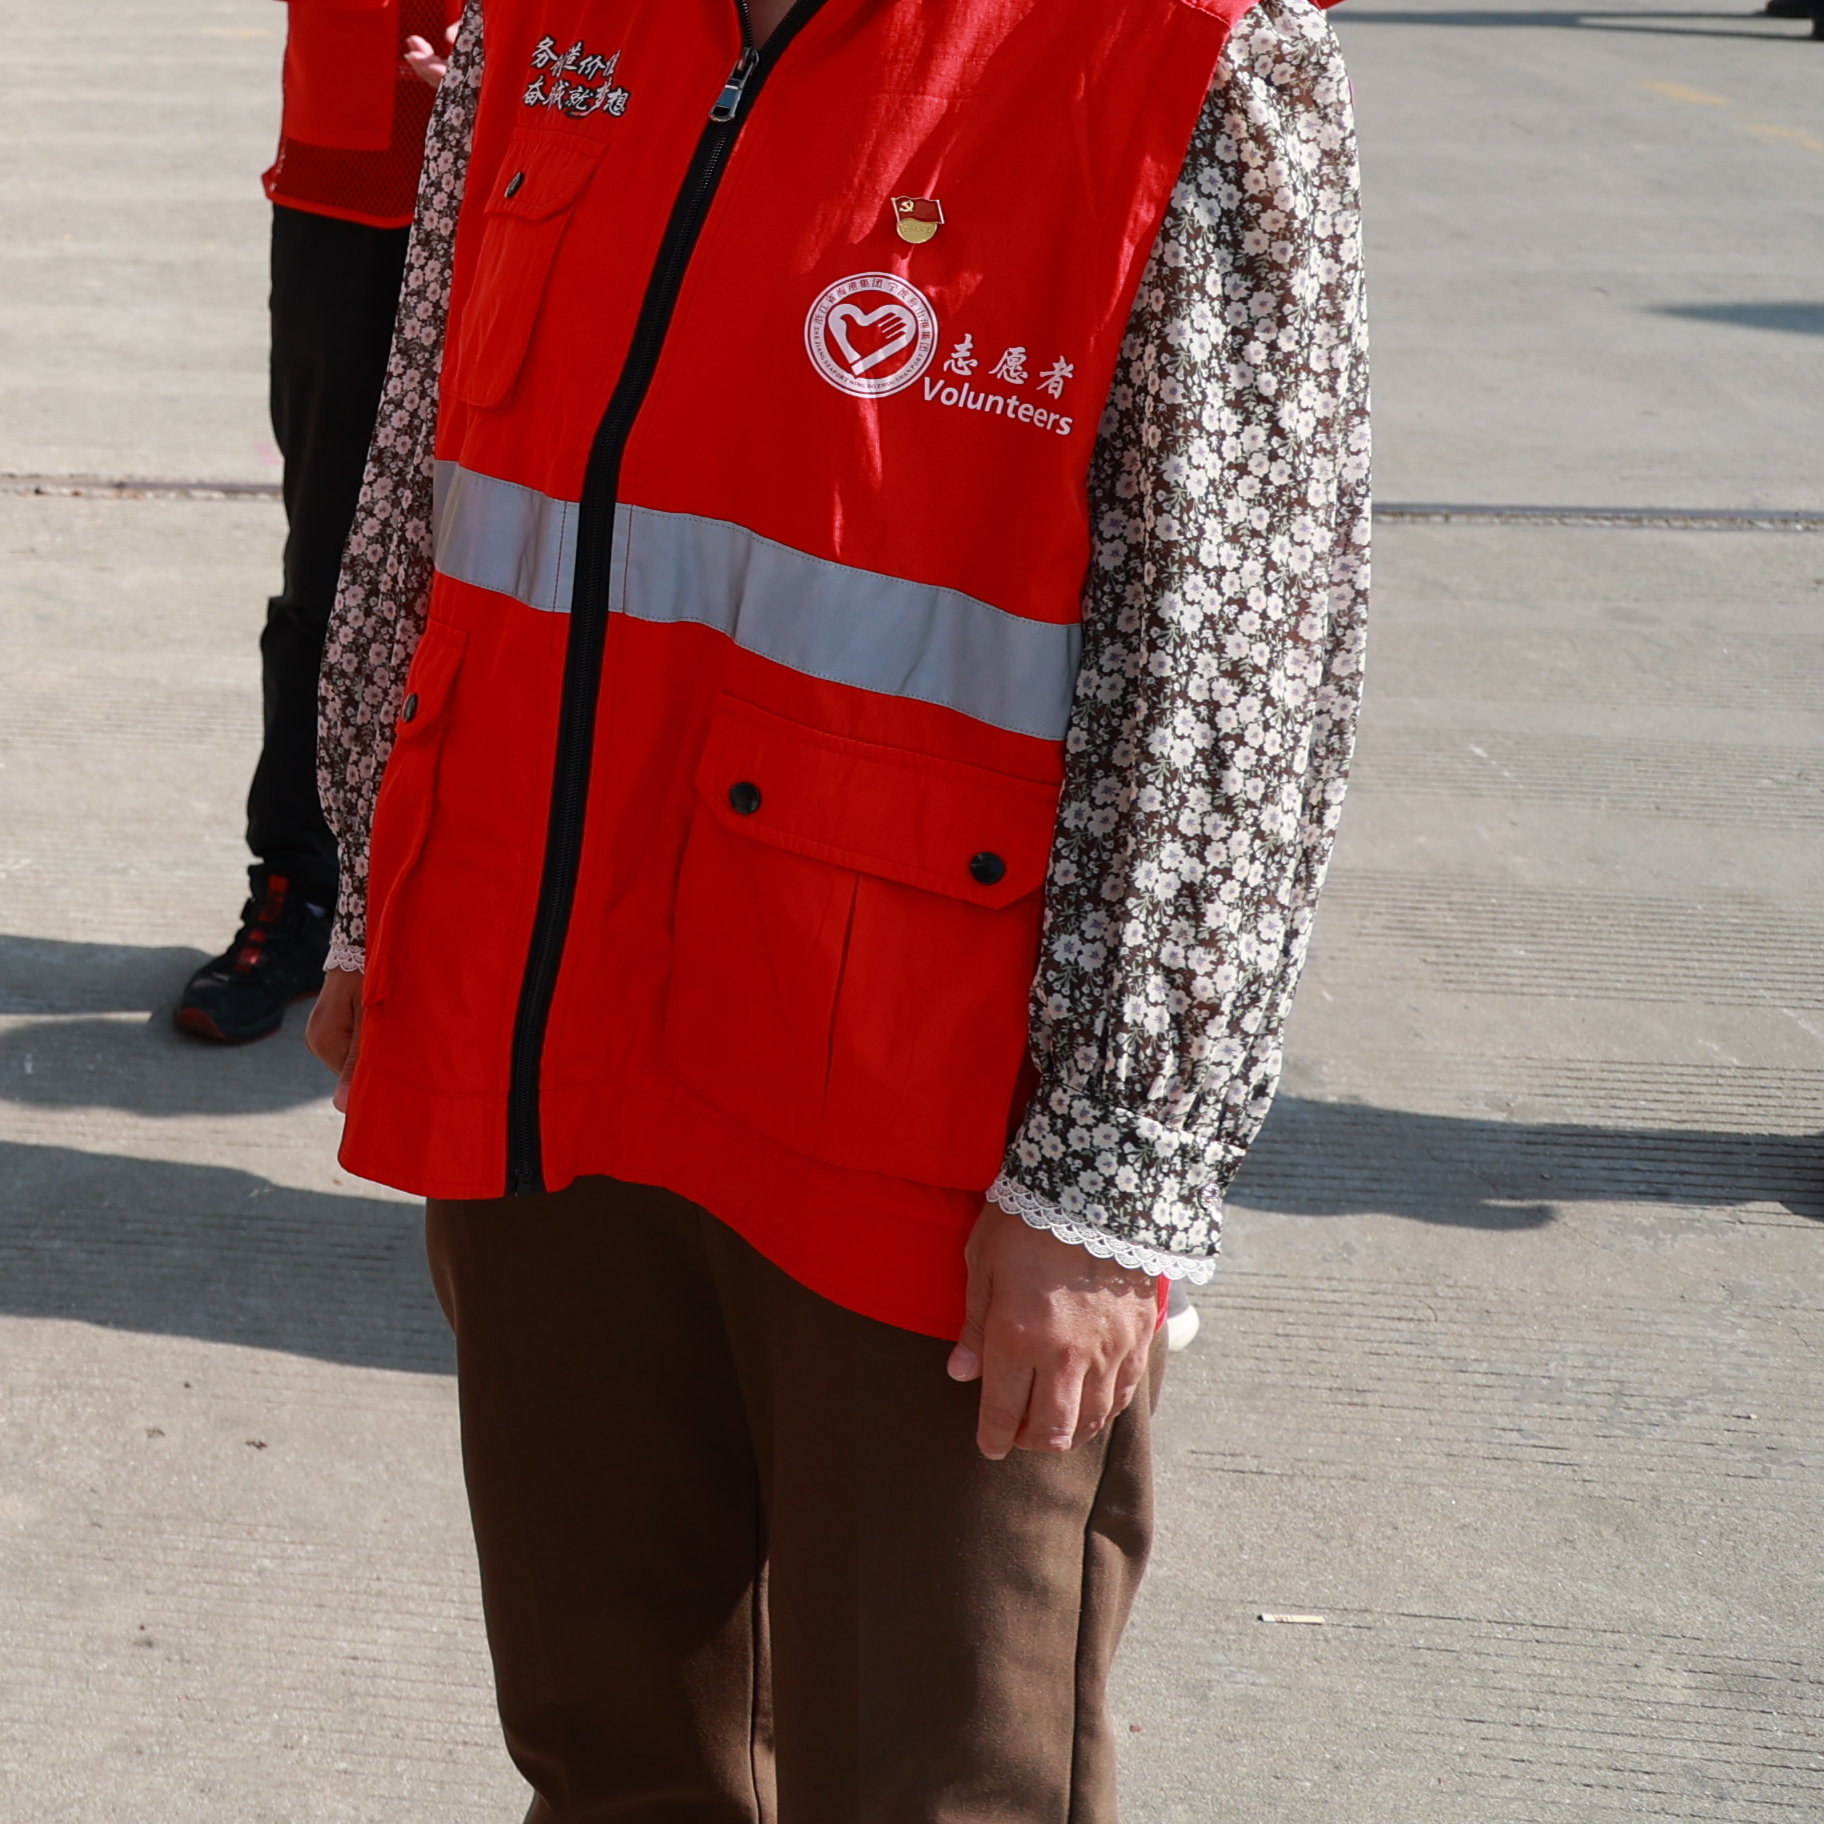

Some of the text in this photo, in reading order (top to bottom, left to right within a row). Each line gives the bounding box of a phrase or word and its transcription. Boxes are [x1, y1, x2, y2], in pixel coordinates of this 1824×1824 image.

[943, 333, 1074, 400] 志愿者
[923, 376, 1073, 436] Volunteers
